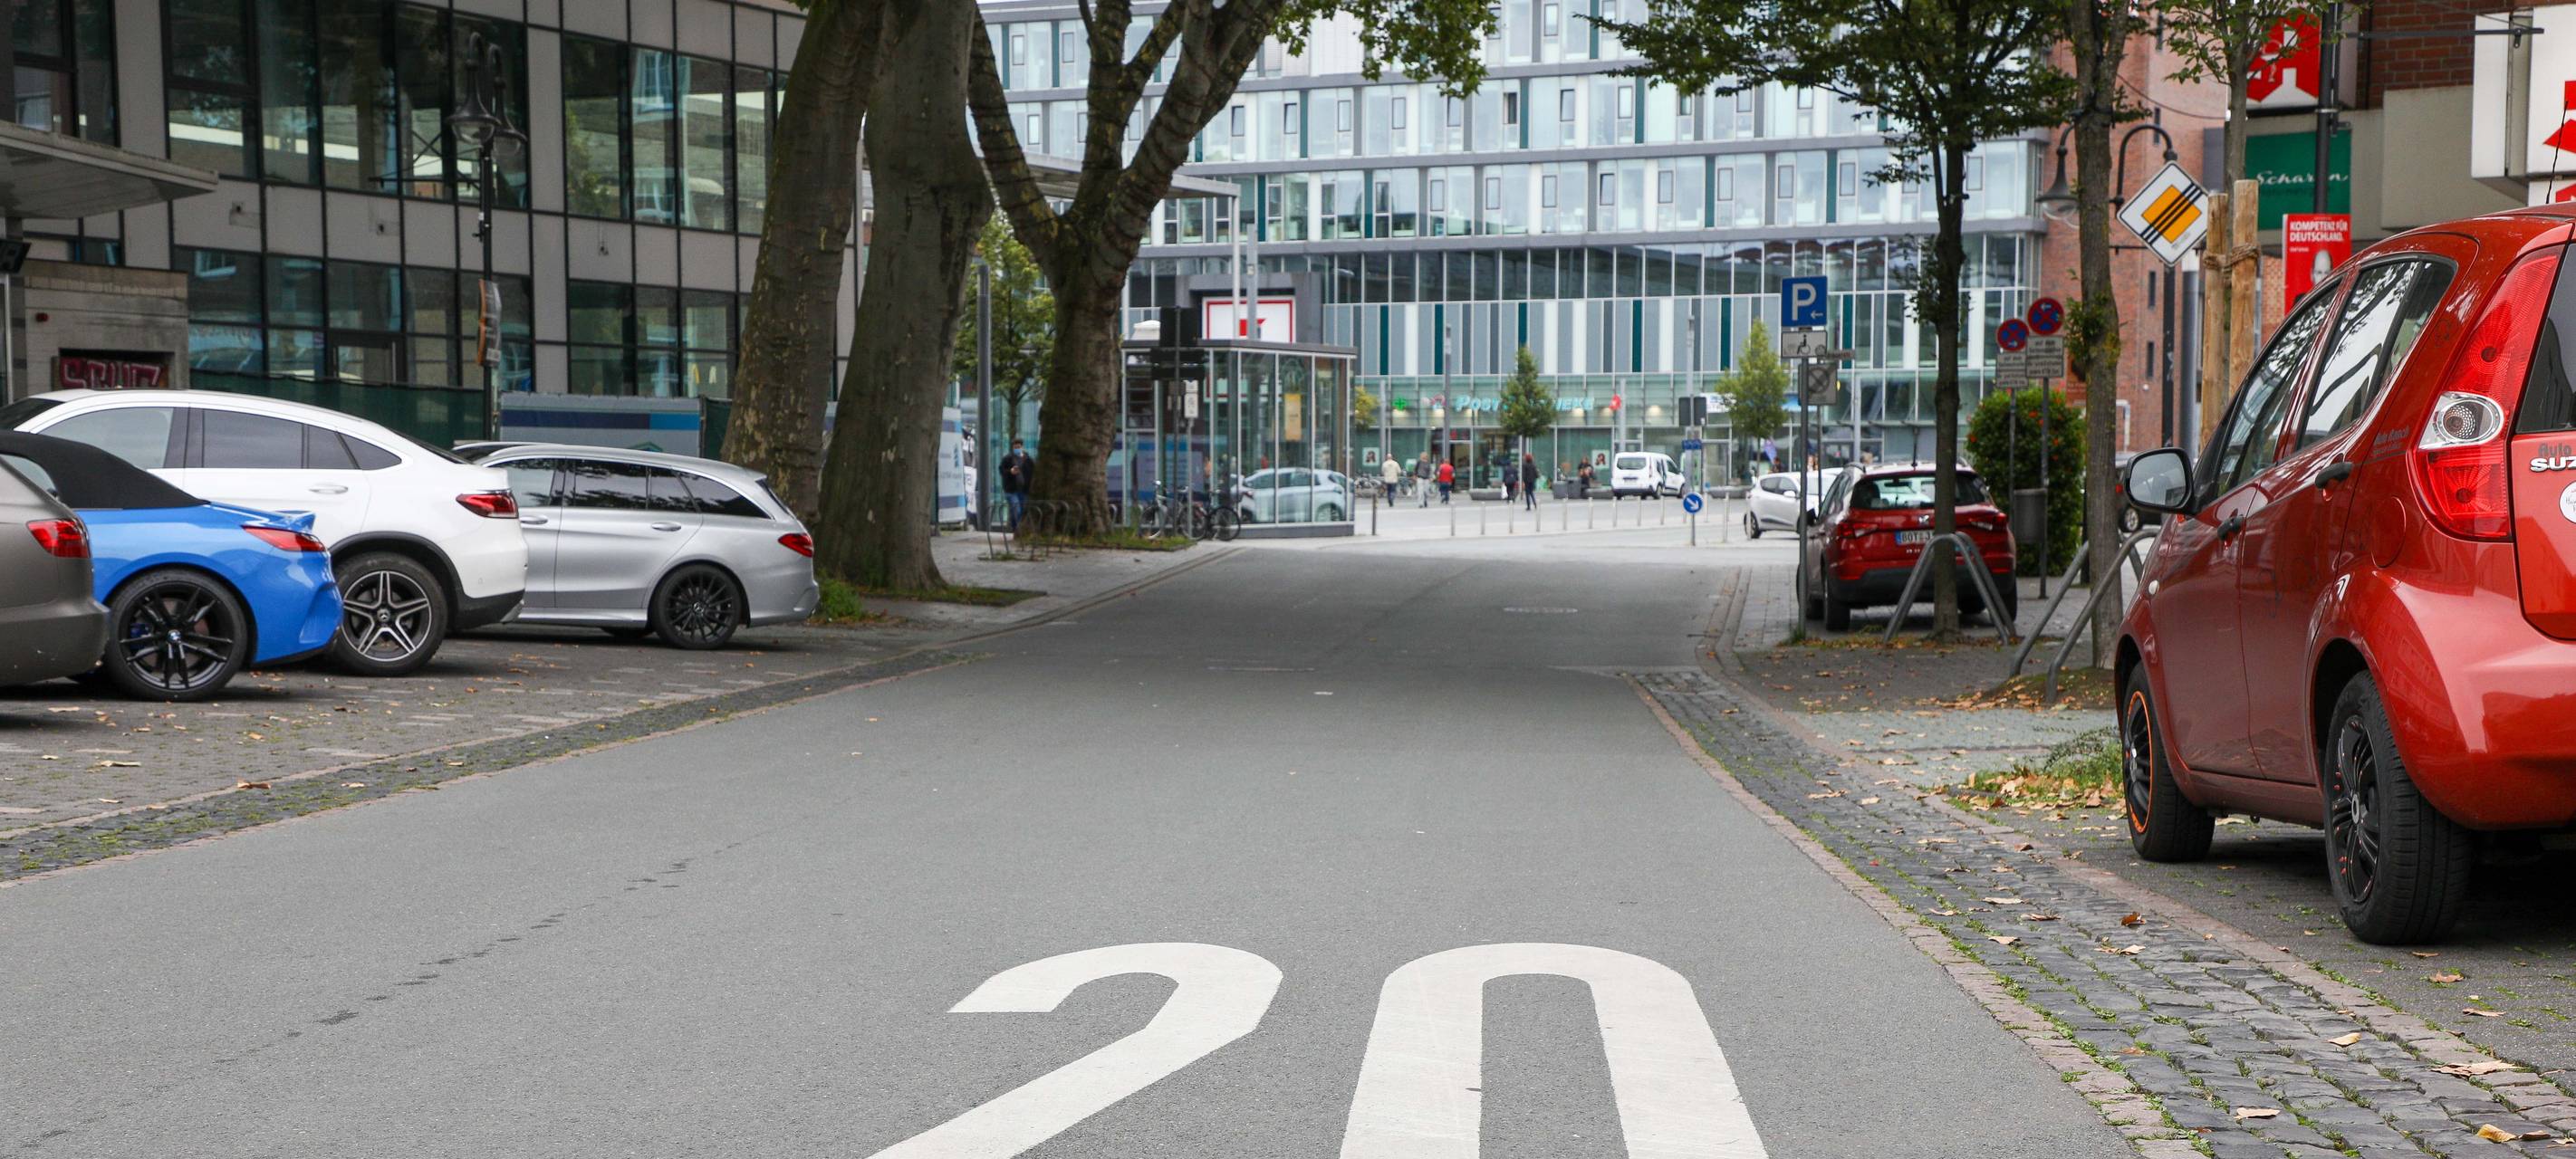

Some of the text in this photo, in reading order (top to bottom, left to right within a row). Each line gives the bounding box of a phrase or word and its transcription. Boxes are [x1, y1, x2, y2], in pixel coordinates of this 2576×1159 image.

[2290, 221, 2334, 231] KOMPETENZ
[1792, 283, 1817, 321] P
[865, 943, 1769, 1159] 20
